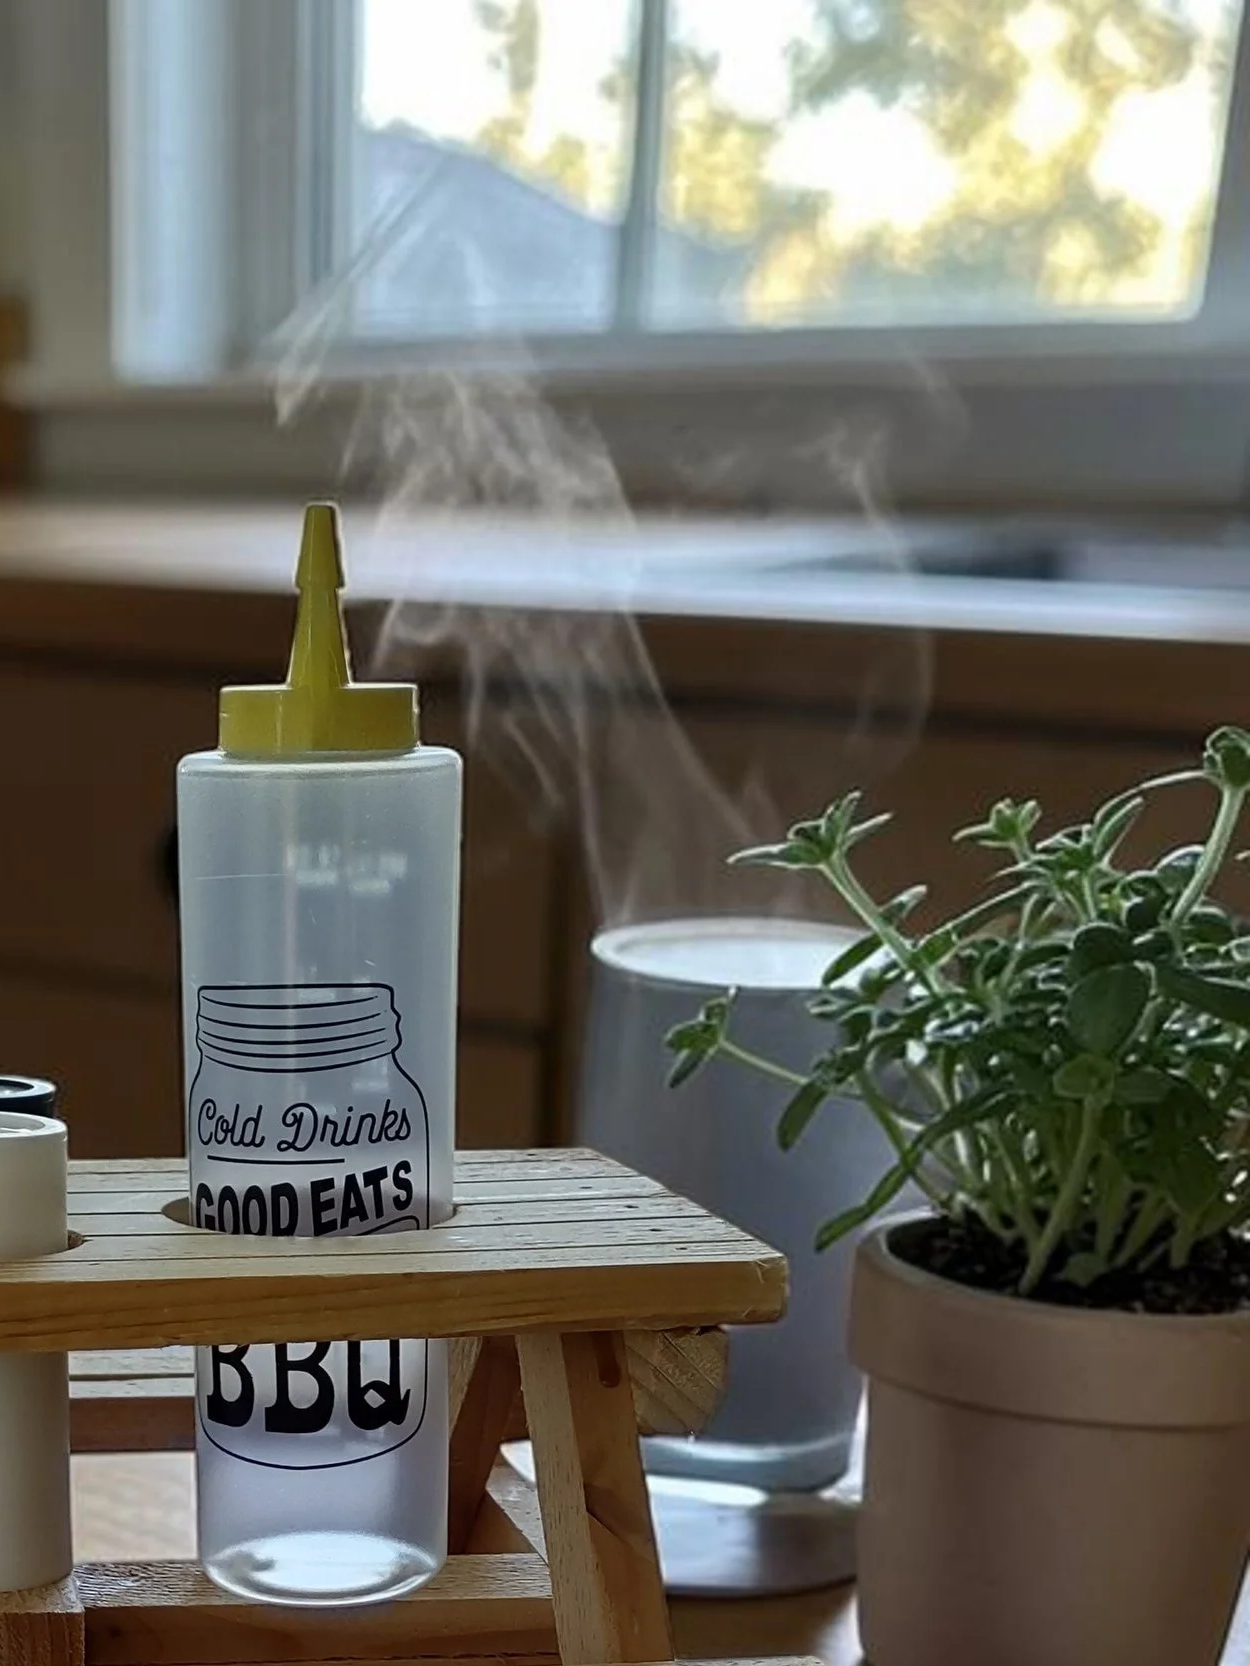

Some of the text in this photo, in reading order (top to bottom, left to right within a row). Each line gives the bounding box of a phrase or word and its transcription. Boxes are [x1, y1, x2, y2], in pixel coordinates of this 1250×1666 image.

[197, 1097, 412, 1152] Cold Drinks
[195, 1159, 414, 1237] GOOD EATS
[206, 1339, 412, 1434] BBQ
